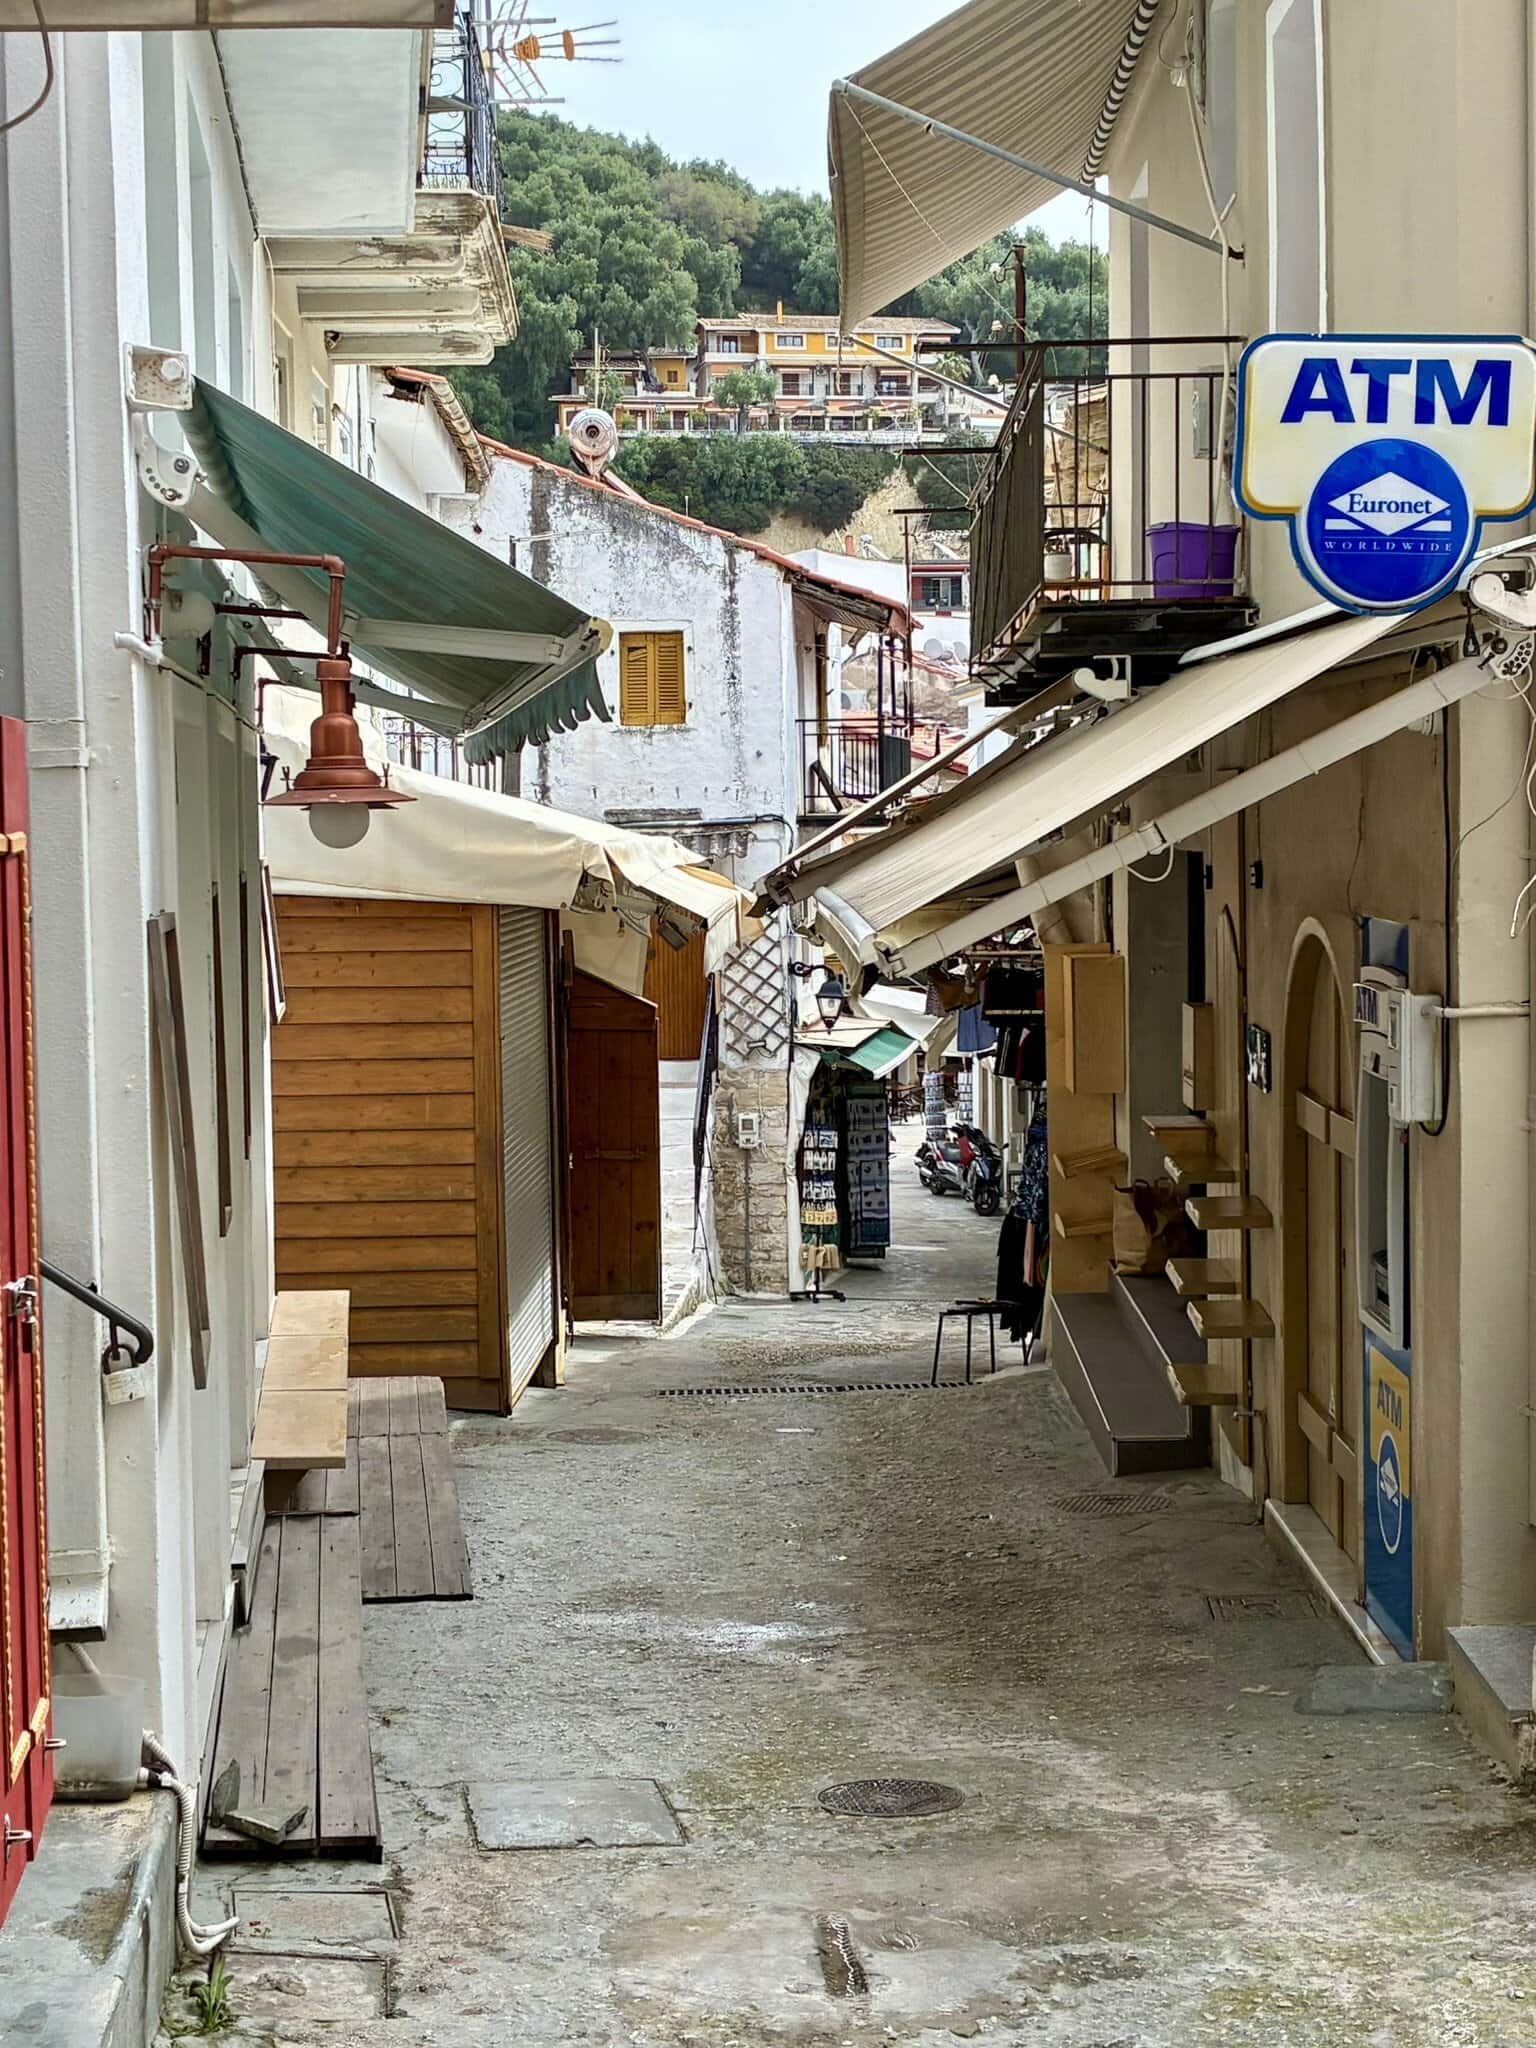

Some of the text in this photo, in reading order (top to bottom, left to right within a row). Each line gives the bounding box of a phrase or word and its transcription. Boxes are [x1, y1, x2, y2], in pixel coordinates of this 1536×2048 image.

[1280, 358, 1511, 426] ATM
[1347, 493, 1433, 514] Euronet
[1324, 541, 1452, 551] WORLDWIDE
[1355, 986, 1377, 1025] ATM
[1377, 1379, 1402, 1431] ATM
